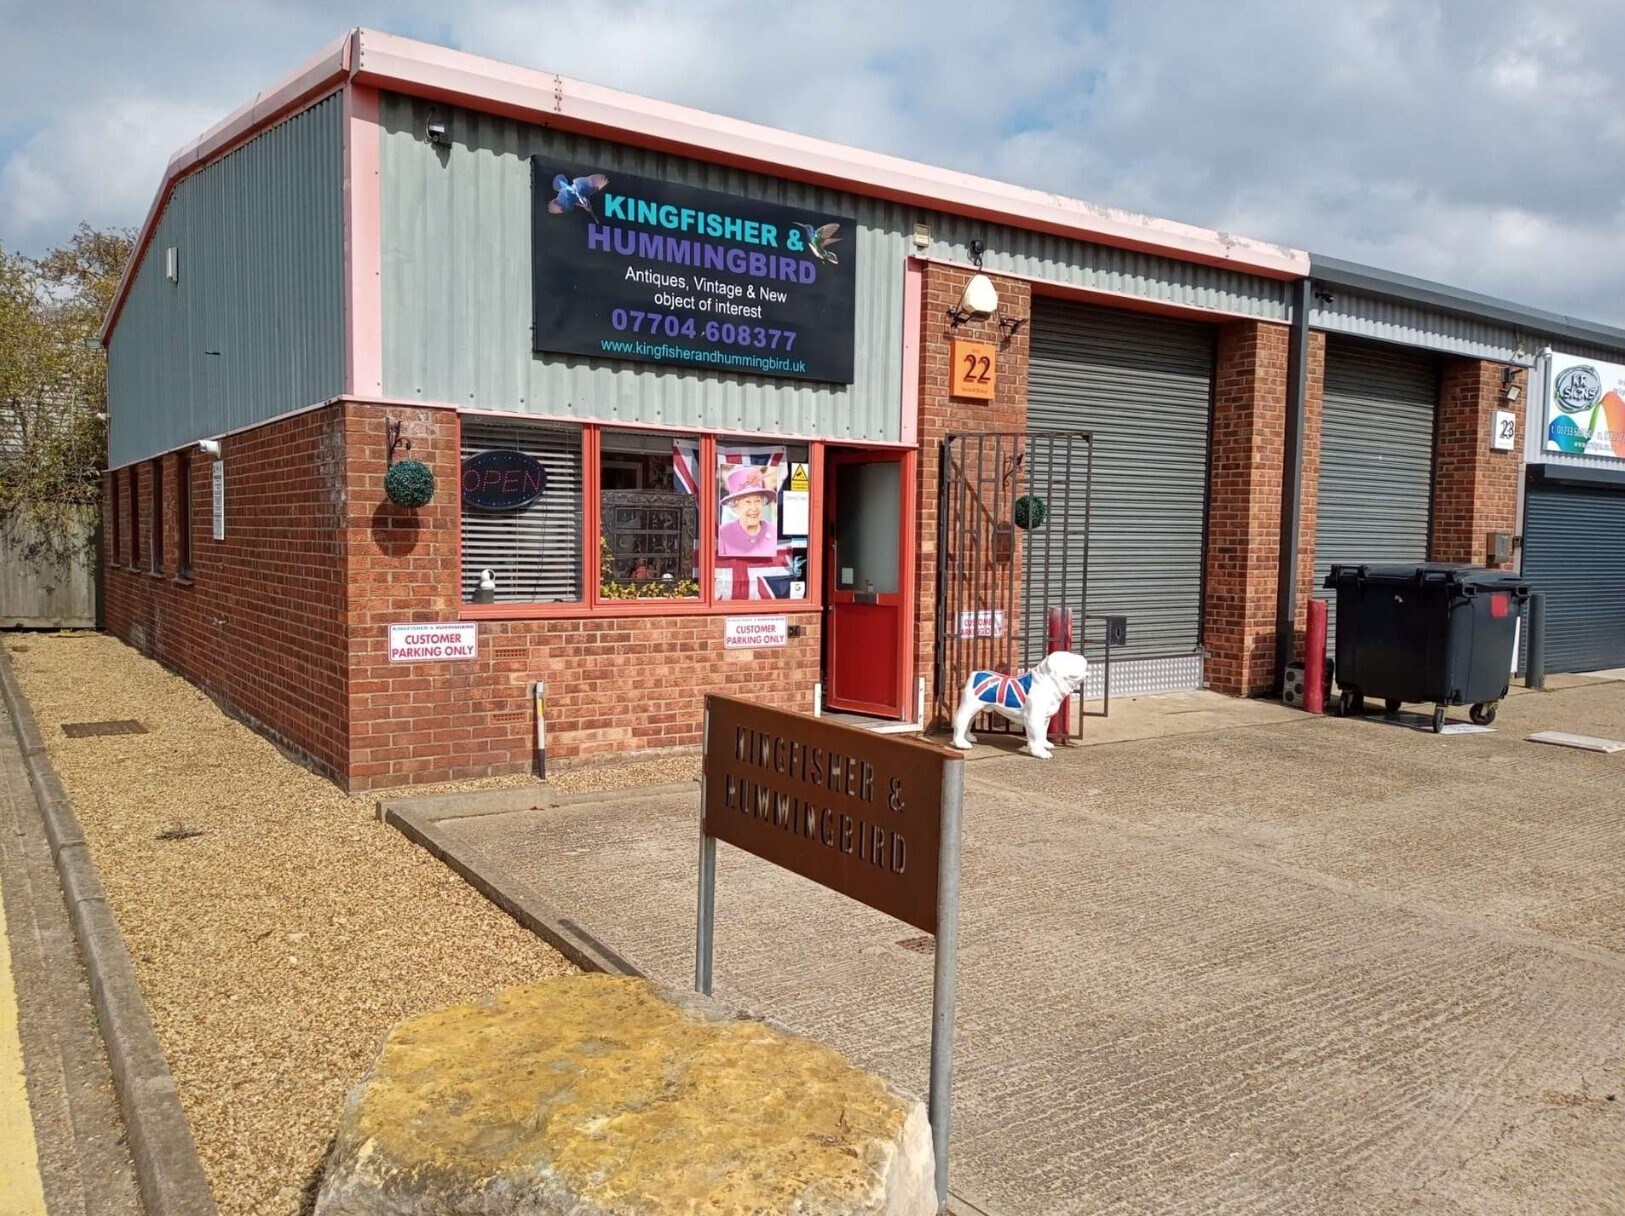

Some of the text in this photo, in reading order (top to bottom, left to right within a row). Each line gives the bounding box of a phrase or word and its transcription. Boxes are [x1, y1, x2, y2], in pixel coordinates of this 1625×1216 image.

[604, 193, 804, 252] KINGFISHER &
[587, 223, 817, 285] HUMMINGBIRD
[625, 266, 788, 303] Antiques, Vintage & New
[654, 291, 762, 318] object of interest
[611, 308, 797, 351] 07704 608377
[601, 339, 806, 373] www.kingfisherandhummingbird.uk
[963, 354, 991, 384] 22
[1563, 386, 1596, 400] SIGNS
[1500, 419, 1515, 438] 23
[462, 468, 541, 493] OPEN
[404, 633, 462, 645] CUSTOMER
[726, 634, 785, 645] PARKING ONLY
[735, 624, 776, 634] CUSTOMER
[392, 645, 474, 658] PARKING ONLY
[735, 725, 905, 814] KINGFISHER &
[725, 773, 907, 875] HUMMINGBIRD
